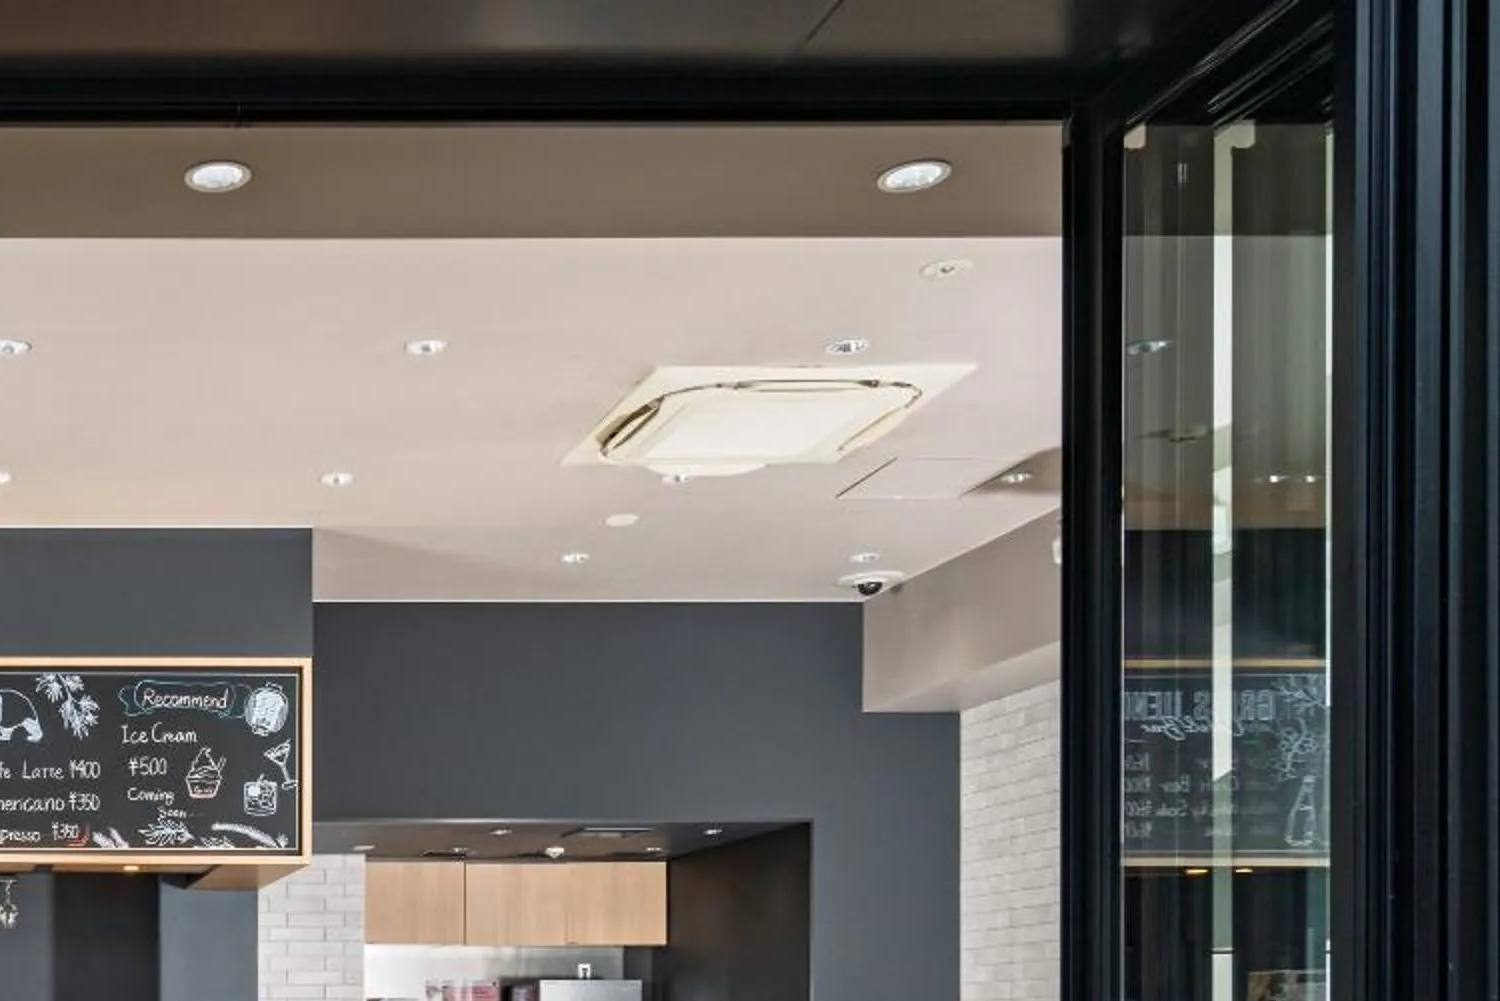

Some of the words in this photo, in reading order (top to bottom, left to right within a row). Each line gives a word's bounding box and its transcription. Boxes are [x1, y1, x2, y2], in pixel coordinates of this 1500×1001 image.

[143, 687, 229, 709] Recommend
[121, 725, 149, 743] Ice
[151, 721, 198, 743] Cream
[22, 760, 64, 779] Latte
[128, 757, 167, 776] ¥500
[127, 787, 175, 806] Coming
